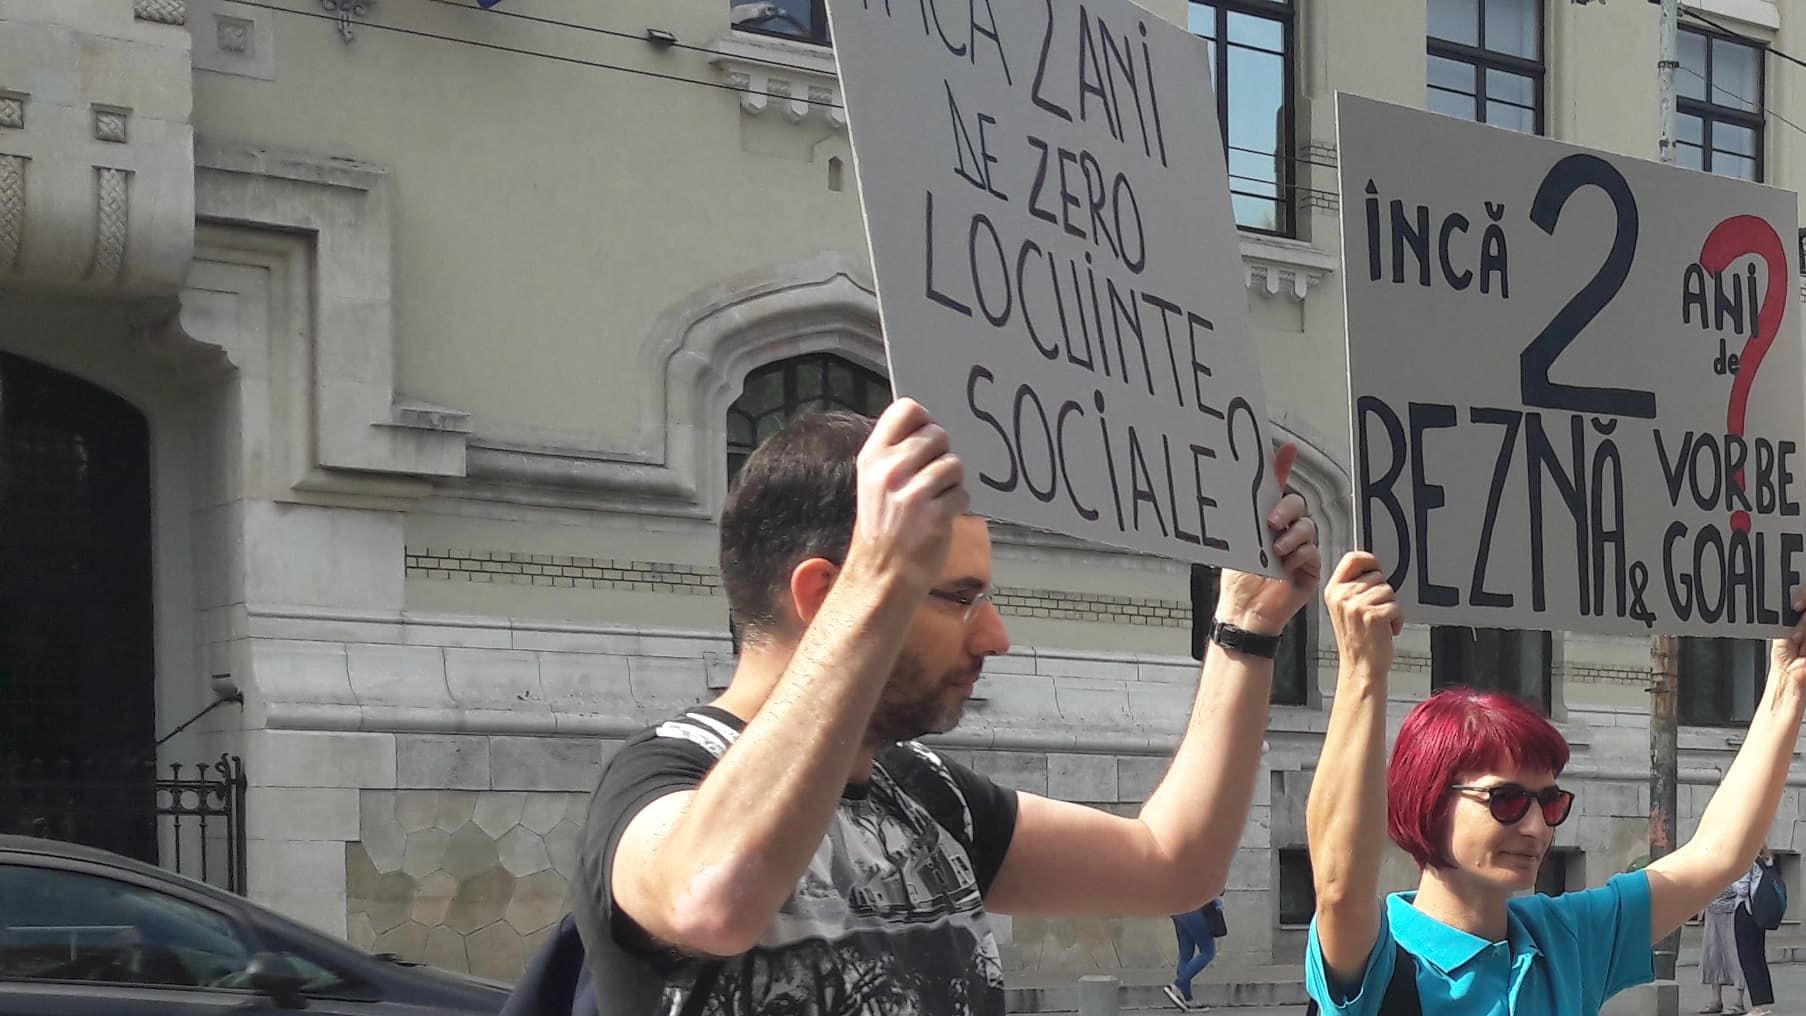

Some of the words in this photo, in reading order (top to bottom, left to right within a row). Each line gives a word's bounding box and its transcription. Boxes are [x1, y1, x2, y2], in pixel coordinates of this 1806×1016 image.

[944, 78, 1008, 201] DE
[1027, 134, 1146, 275] ZERO
[1364, 178, 1510, 299] ÎNCĂ
[1519, 153, 1657, 419] 2
[1713, 337, 1741, 376] de
[1356, 395, 1627, 617] BEZNĂ
[1628, 560, 1657, 629] &
[1653, 427, 1801, 517] VORBE
[1663, 521, 1804, 627] GOALE
